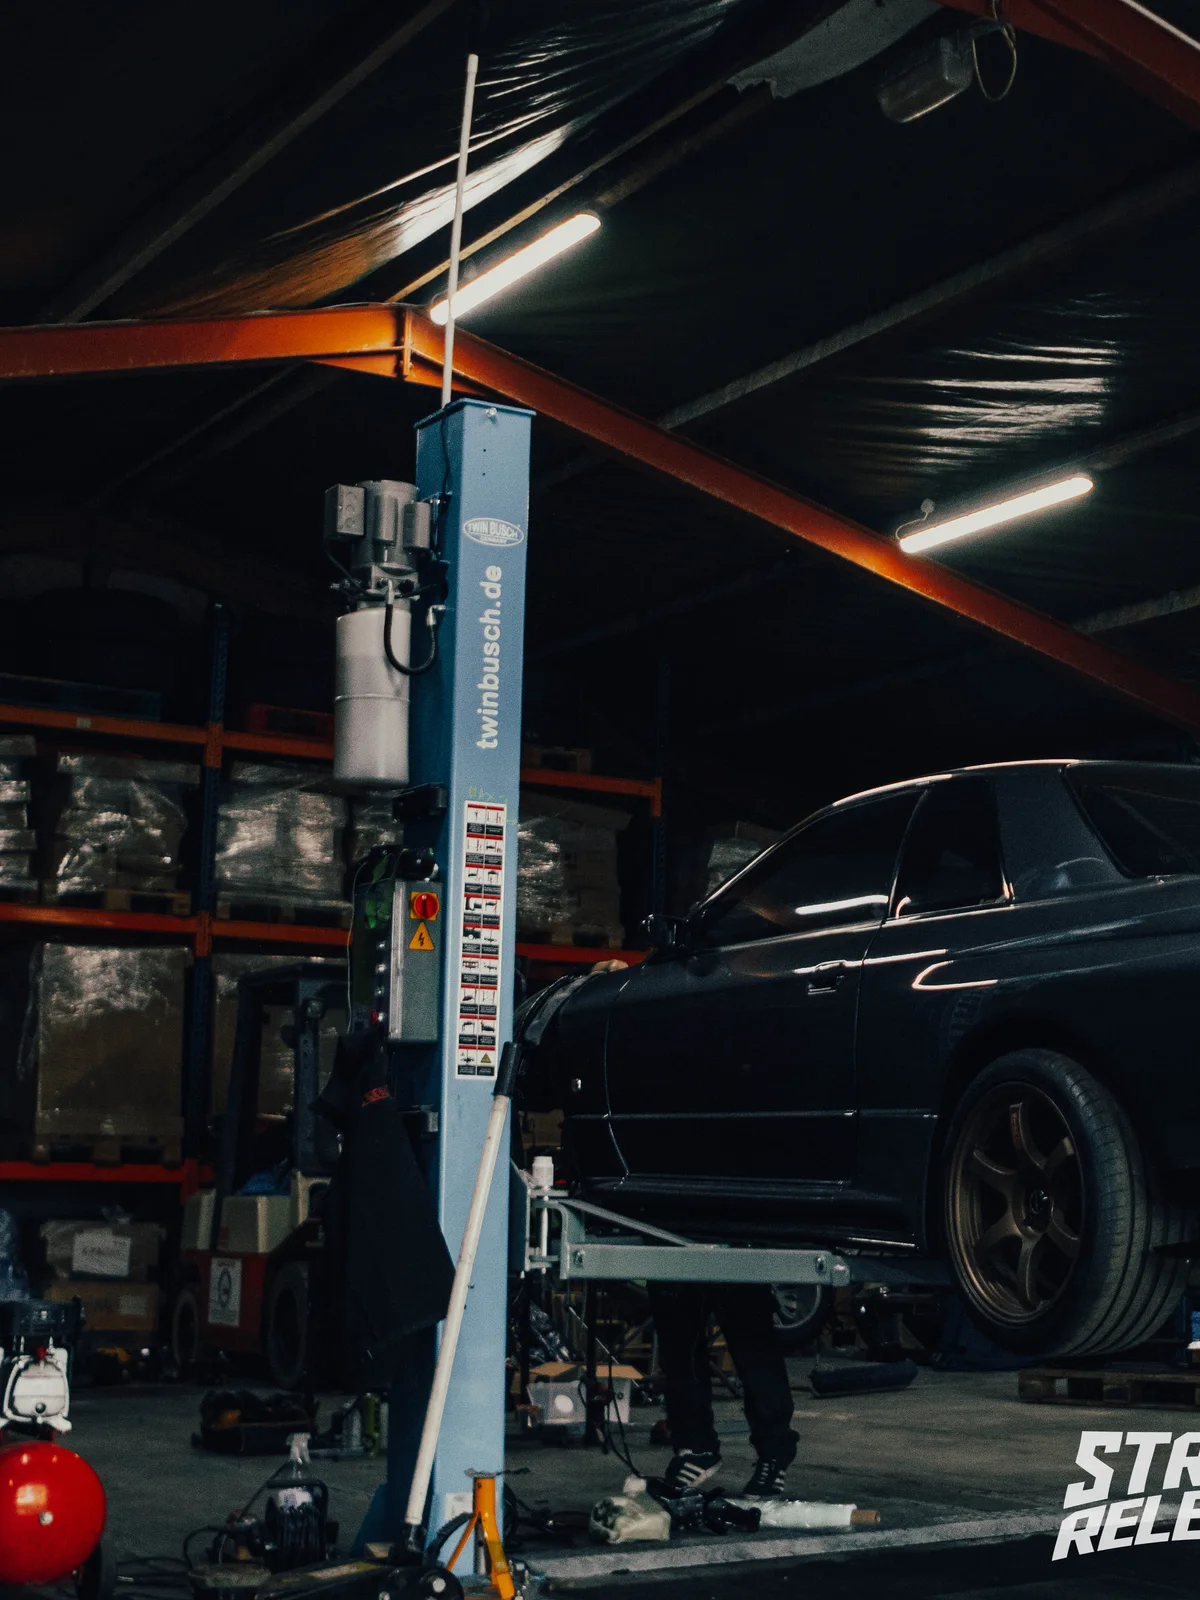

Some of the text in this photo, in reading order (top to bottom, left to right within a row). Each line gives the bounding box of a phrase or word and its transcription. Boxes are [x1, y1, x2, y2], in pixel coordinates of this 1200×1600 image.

[468, 520, 519, 540] TWIN BUSCH
[477, 565, 502, 749] twinbusch.de
